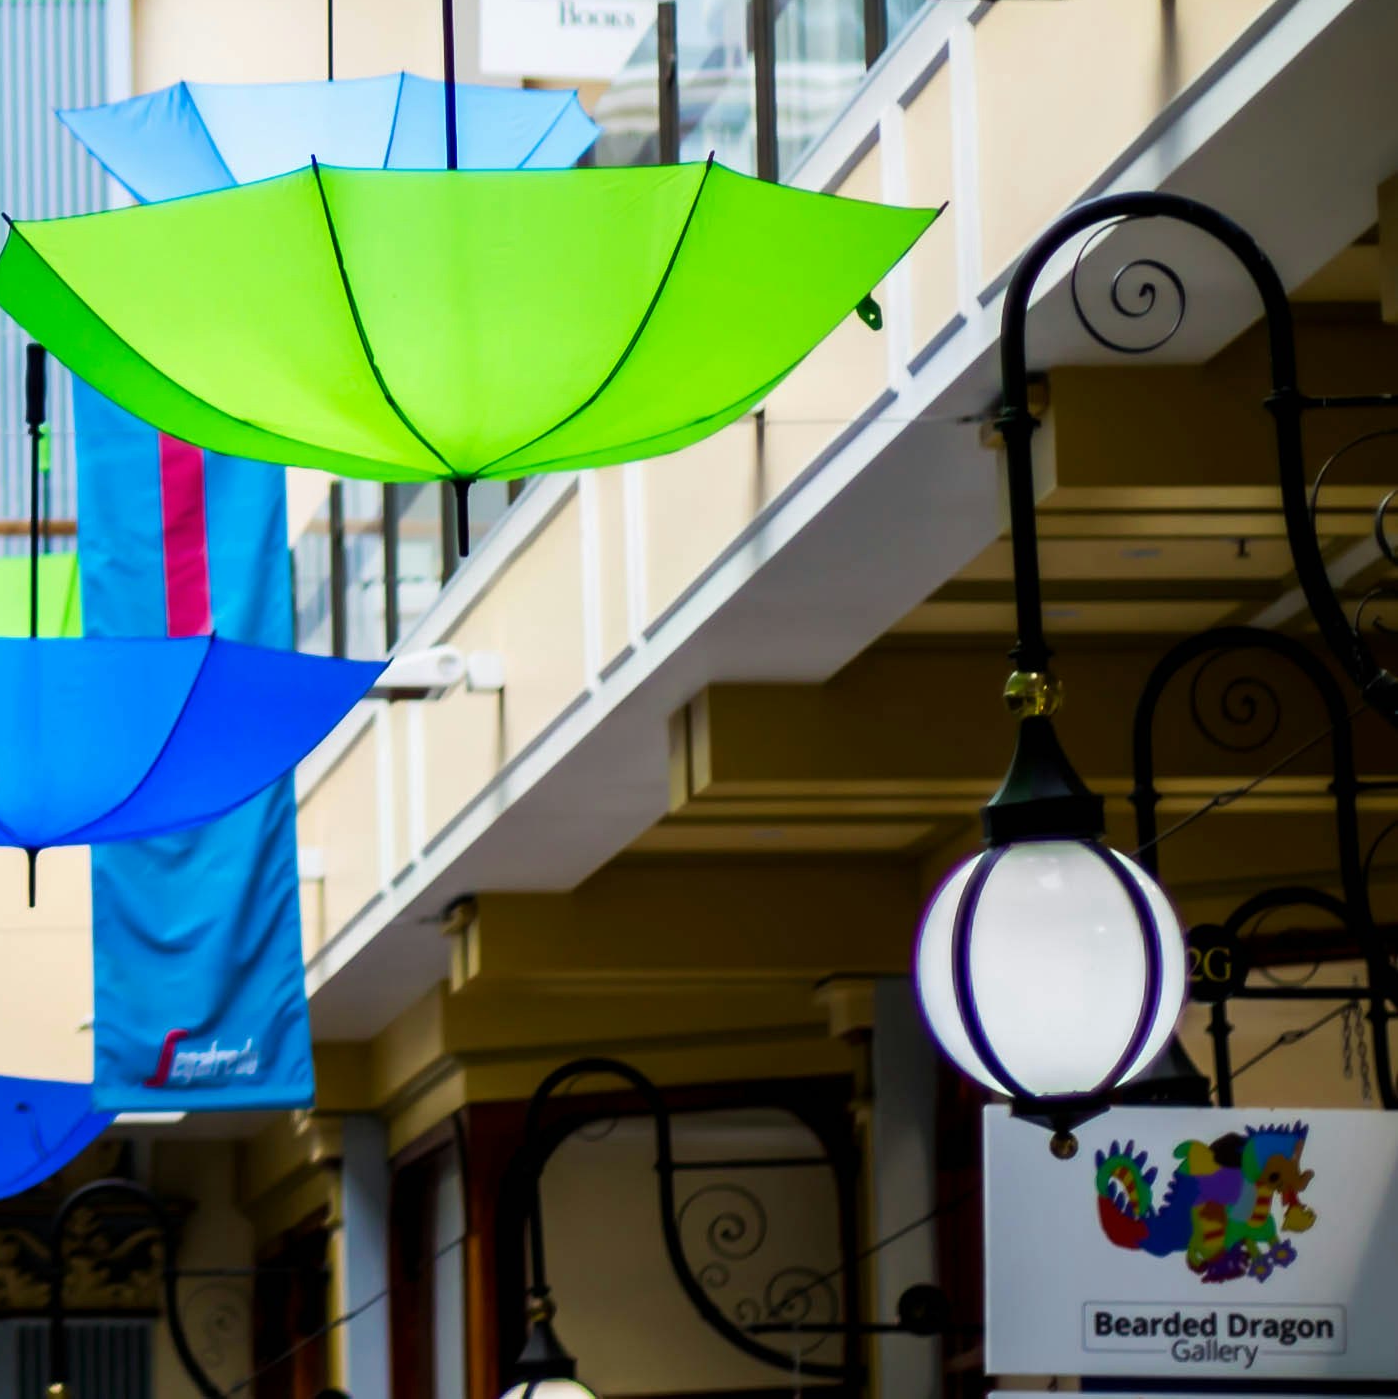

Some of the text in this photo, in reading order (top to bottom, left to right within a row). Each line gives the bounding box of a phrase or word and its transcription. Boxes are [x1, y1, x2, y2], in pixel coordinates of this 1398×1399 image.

[1189, 946, 1231, 982] 2G
[1094, 1312, 1335, 1345] Bearded Dragon
[1170, 1338, 1260, 1370] Gallery
